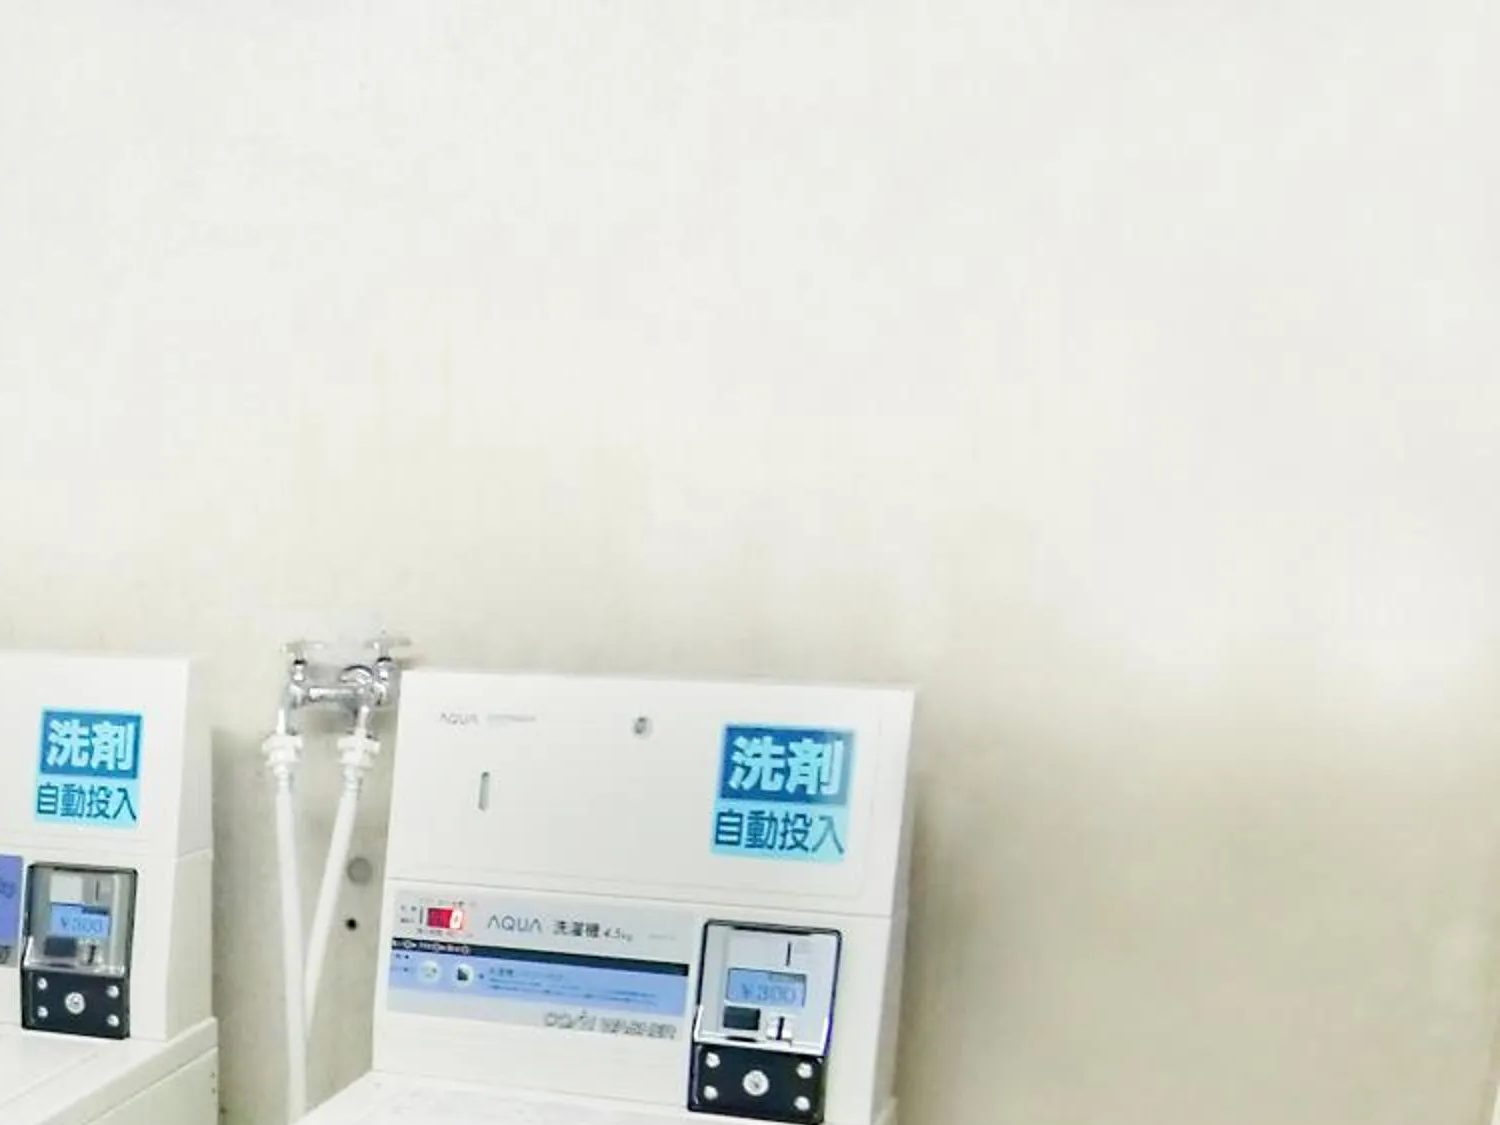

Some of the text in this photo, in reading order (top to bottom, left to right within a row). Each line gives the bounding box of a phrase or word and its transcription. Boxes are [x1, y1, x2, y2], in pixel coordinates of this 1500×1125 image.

[46, 719, 135, 770] 洗剤
[728, 735, 844, 795] 洗剤
[37, 782, 137, 820] 自動投入
[714, 808, 845, 854] 自動投入
[487, 914, 543, 933] AQUA
[552, 918, 601, 939] 洗濯機
